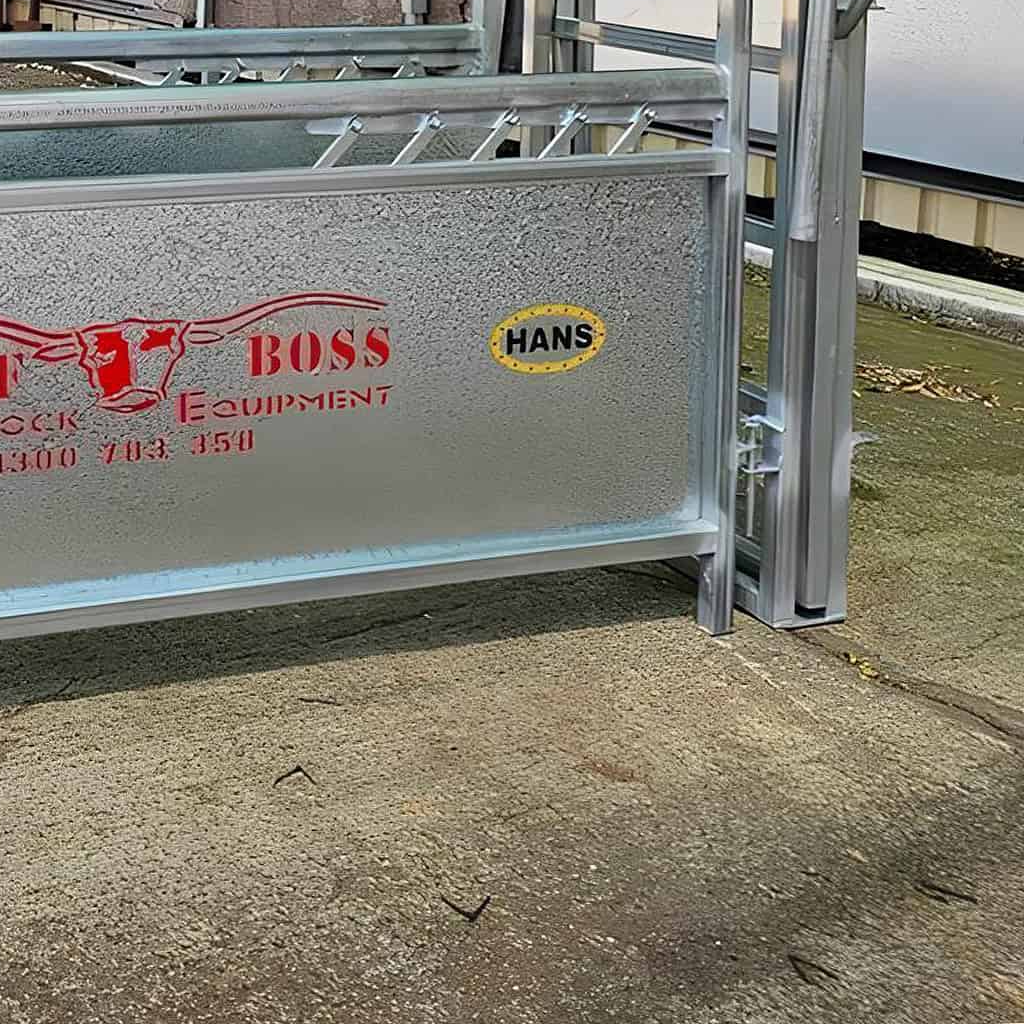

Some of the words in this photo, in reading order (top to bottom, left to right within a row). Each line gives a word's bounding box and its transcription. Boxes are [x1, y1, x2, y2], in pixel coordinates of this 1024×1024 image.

[248, 326, 391, 377] BOSS
[506, 323, 593, 355] HANS
[178, 384, 394, 424] EQUIPMENT
[190, 428, 255, 455] 350
